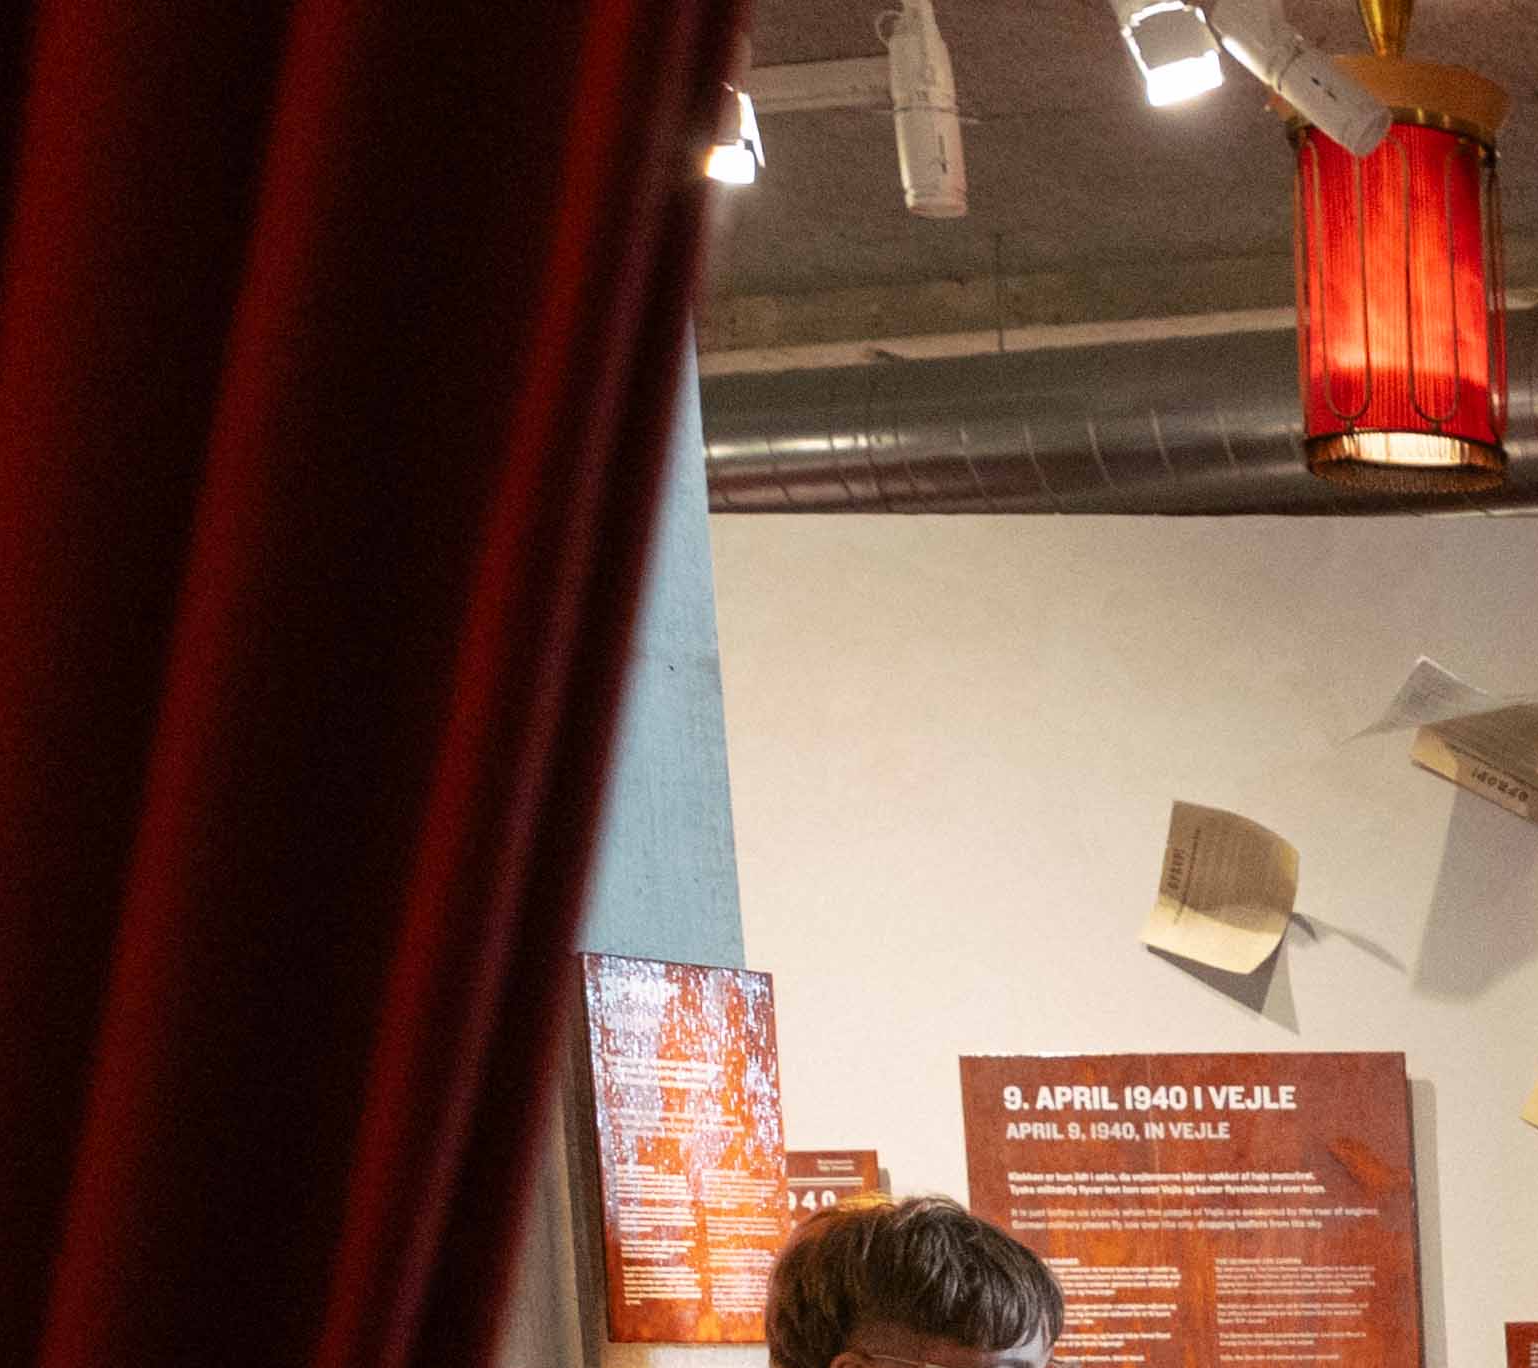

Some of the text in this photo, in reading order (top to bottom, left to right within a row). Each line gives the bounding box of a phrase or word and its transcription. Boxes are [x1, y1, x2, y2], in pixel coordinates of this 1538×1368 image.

[1003, 1085, 1297, 1110] 9. APRIL 1940 I VEJLE
[1006, 1122, 1231, 1142] APRIL 9, 1940, IN VEJLE
